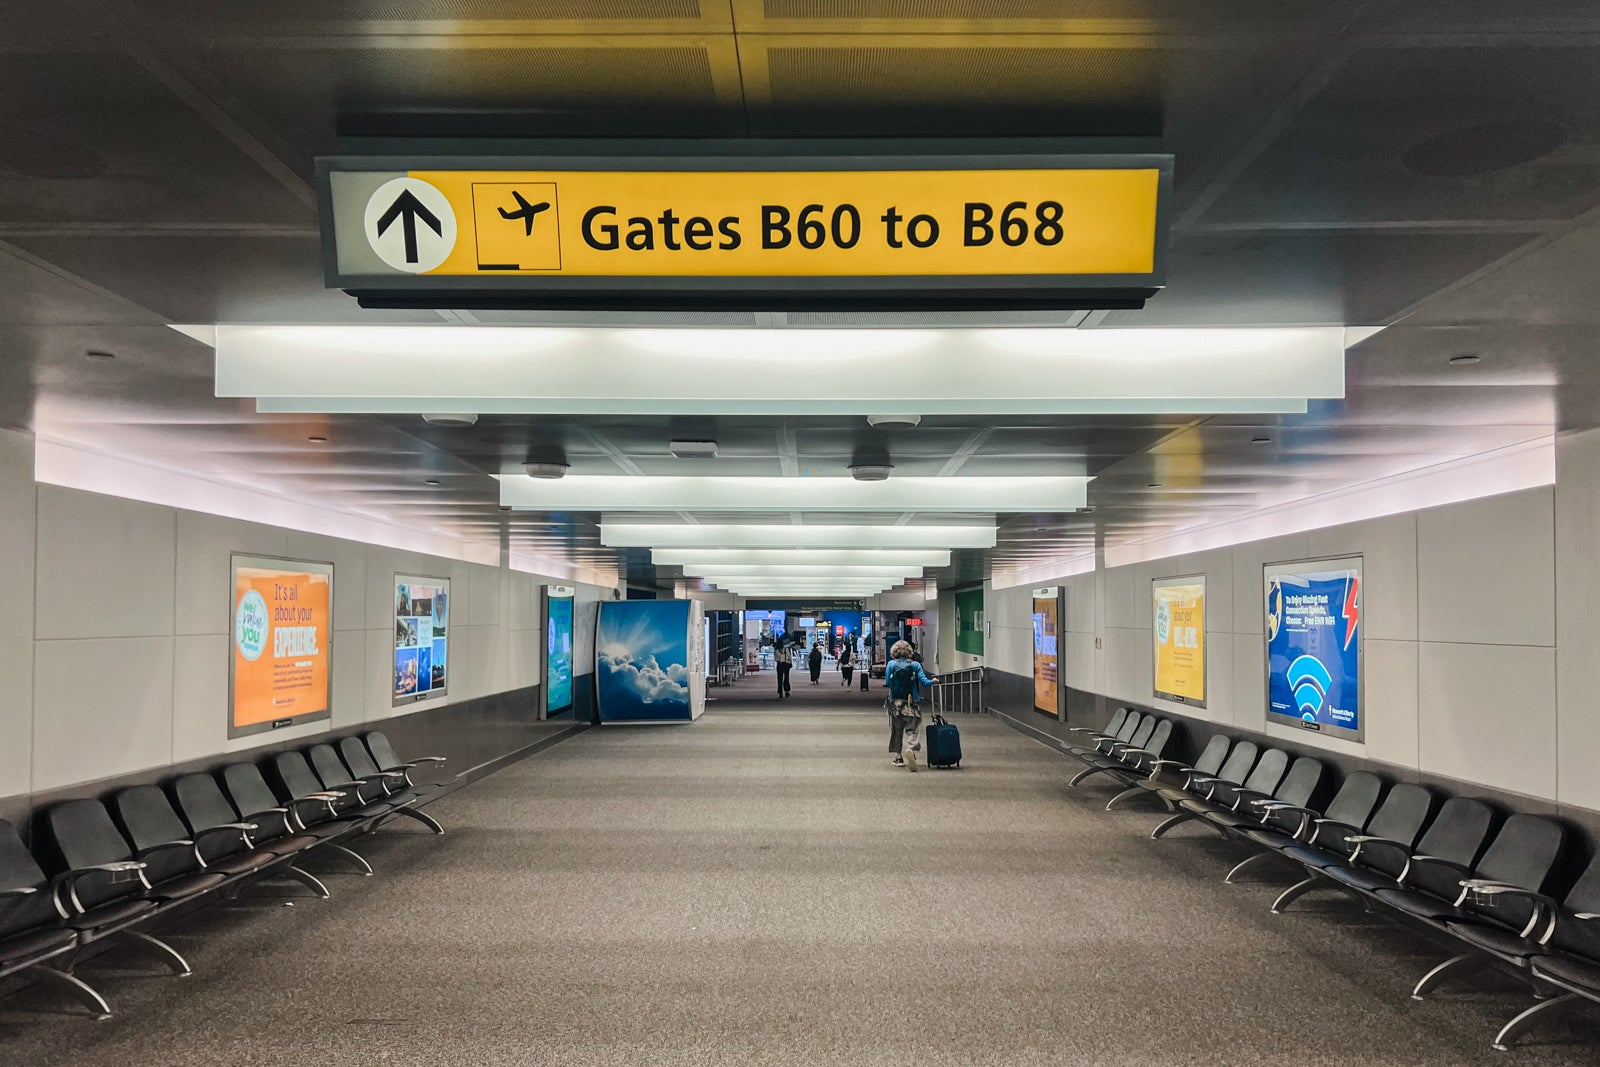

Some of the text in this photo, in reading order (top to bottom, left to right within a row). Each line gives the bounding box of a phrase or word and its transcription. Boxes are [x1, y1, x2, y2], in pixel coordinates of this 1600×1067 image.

[581, 200, 1064, 251] Gates B60 to B68
[275, 584, 298, 600] It's all
[1286, 596, 1291, 604] To
[1291, 595, 1303, 606] Enjoy
[1318, 594, 1328, 604] Fast
[244, 602, 254, 613] we
[275, 605, 312, 624] about your
[1286, 605, 1308, 614] Connection
[241, 625, 260, 643] you
